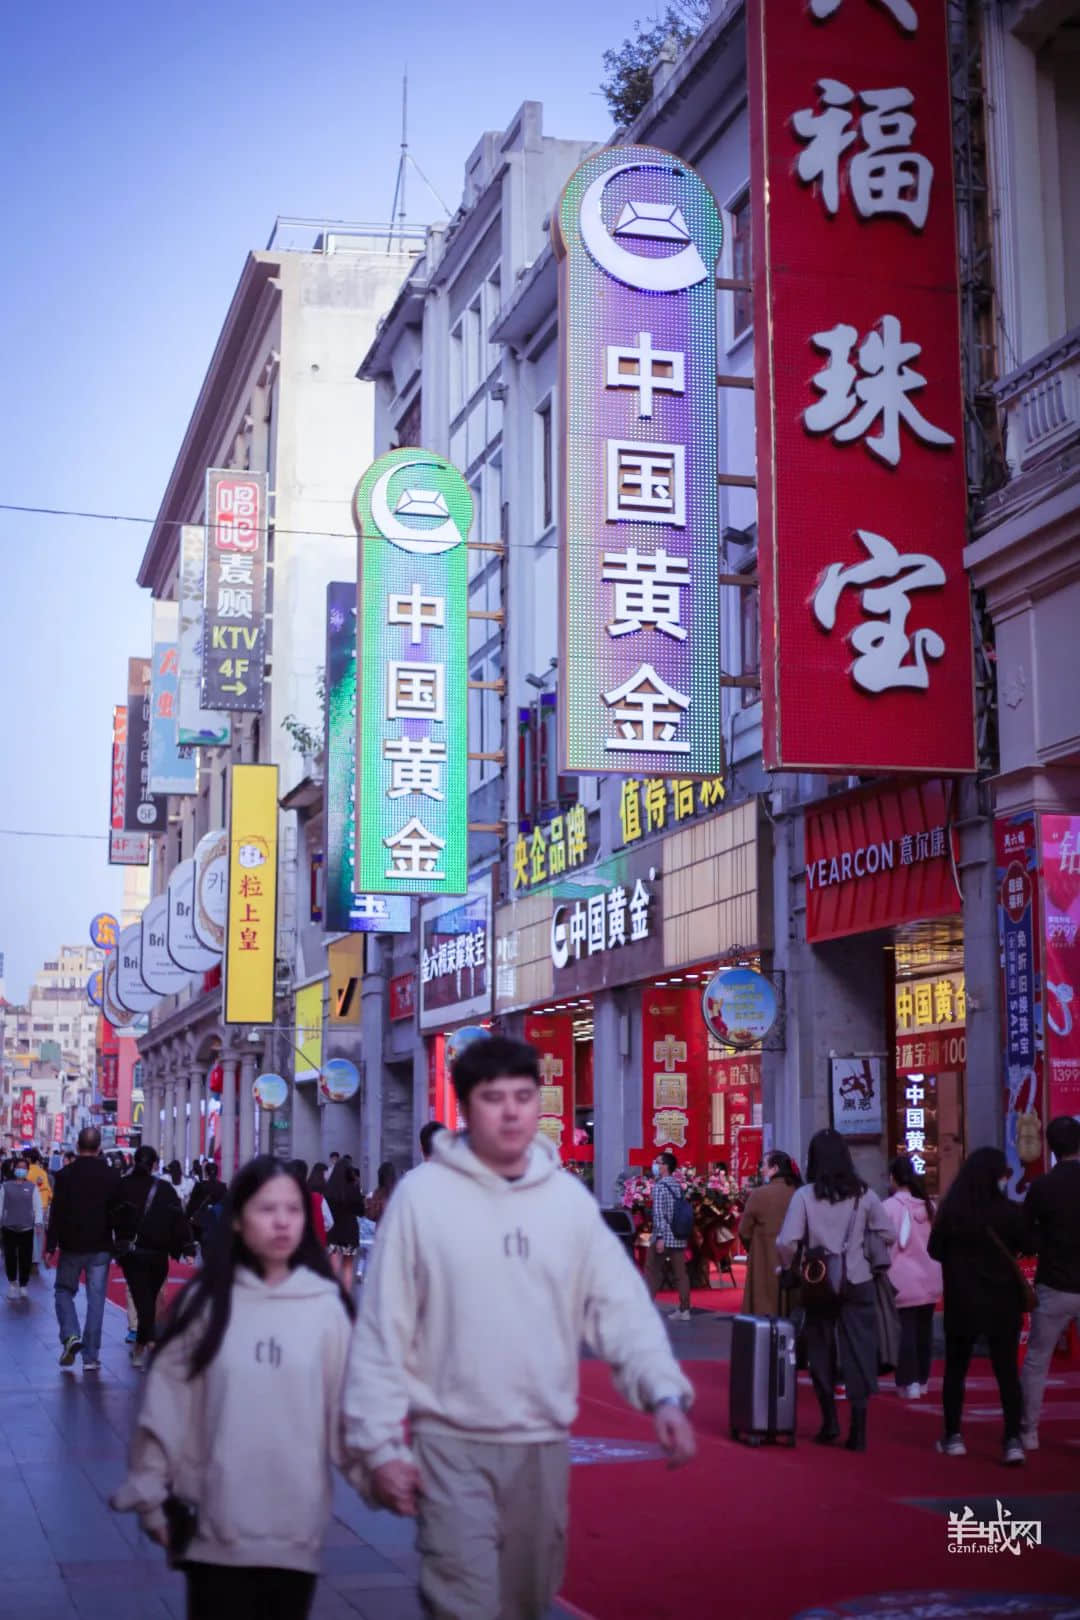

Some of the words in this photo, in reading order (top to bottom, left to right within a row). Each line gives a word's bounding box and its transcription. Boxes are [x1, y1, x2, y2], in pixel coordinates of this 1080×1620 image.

[788, 0, 955, 694] 福珠宝
[601, 330, 692, 754] 中国黄金
[212, 626, 259, 651] KTV
[219, 658, 249, 679] 4F
[383, 583, 446, 880] 中国黄金
[513, 803, 588, 889] 央企品牌
[806, 840, 894, 890] YEARCON
[900, 826, 946, 866] 意尔康
[238, 874, 263, 951] 粒上皇
[570, 878, 650, 960] 中国黄金
